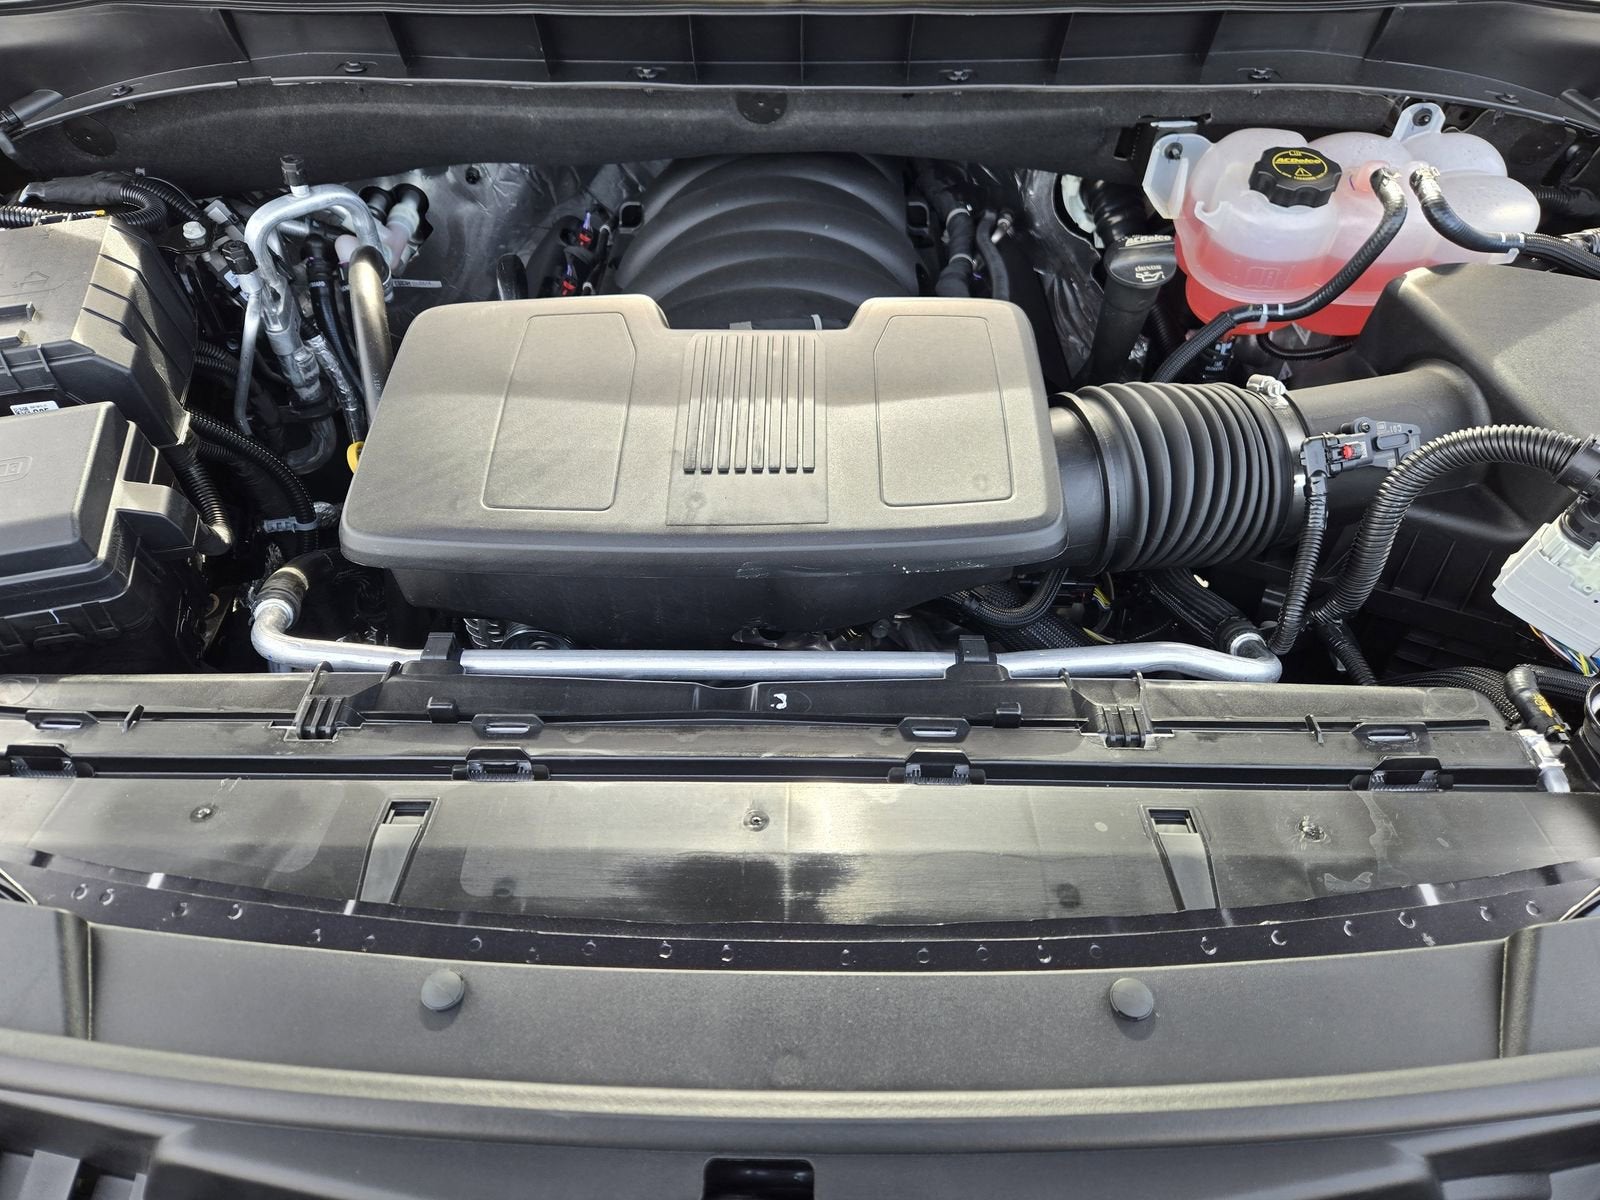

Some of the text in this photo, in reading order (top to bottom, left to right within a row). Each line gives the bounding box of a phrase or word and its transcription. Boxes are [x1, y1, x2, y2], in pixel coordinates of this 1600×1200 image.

[1275, 157, 1321, 165] ACDelco
[1125, 234, 1172, 247] ACDelco
[1134, 265, 1162, 273] dexos
